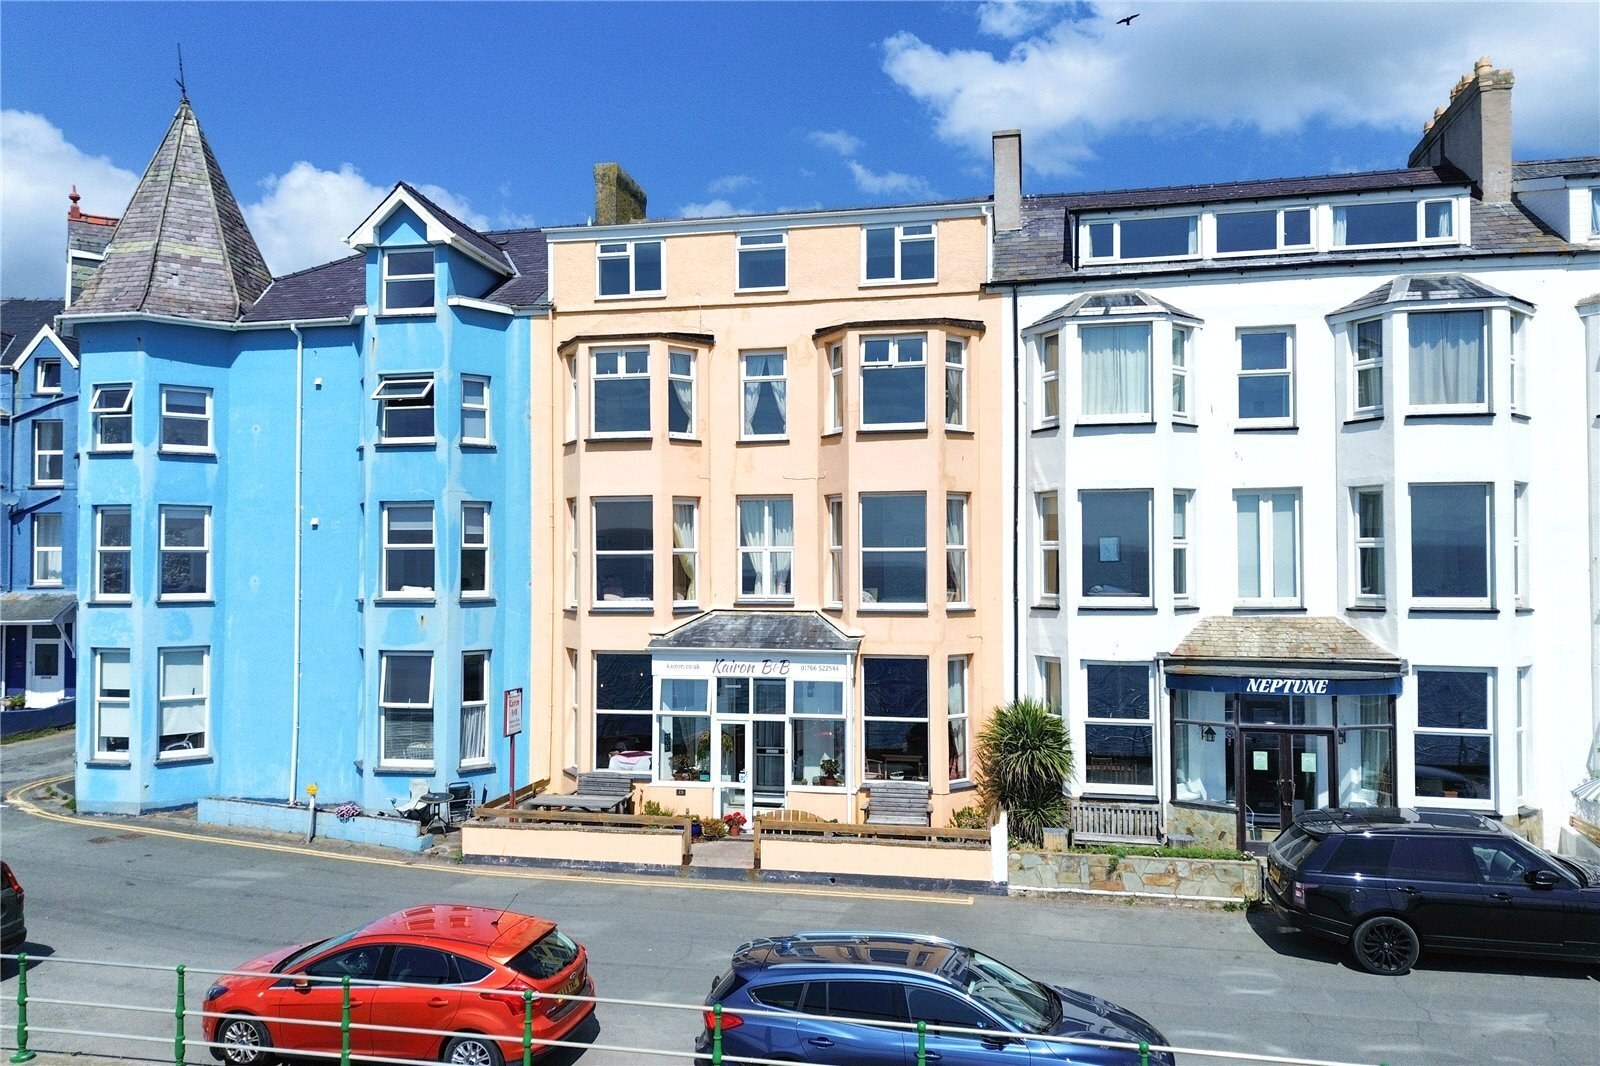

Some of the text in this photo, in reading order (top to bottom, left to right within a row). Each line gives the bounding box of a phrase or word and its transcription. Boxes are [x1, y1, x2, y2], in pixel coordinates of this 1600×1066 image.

[712, 658, 755, 674] Kairon
[800, 664, 840, 672] 01766 522544
[1246, 678, 1329, 694] NEPTUNE
